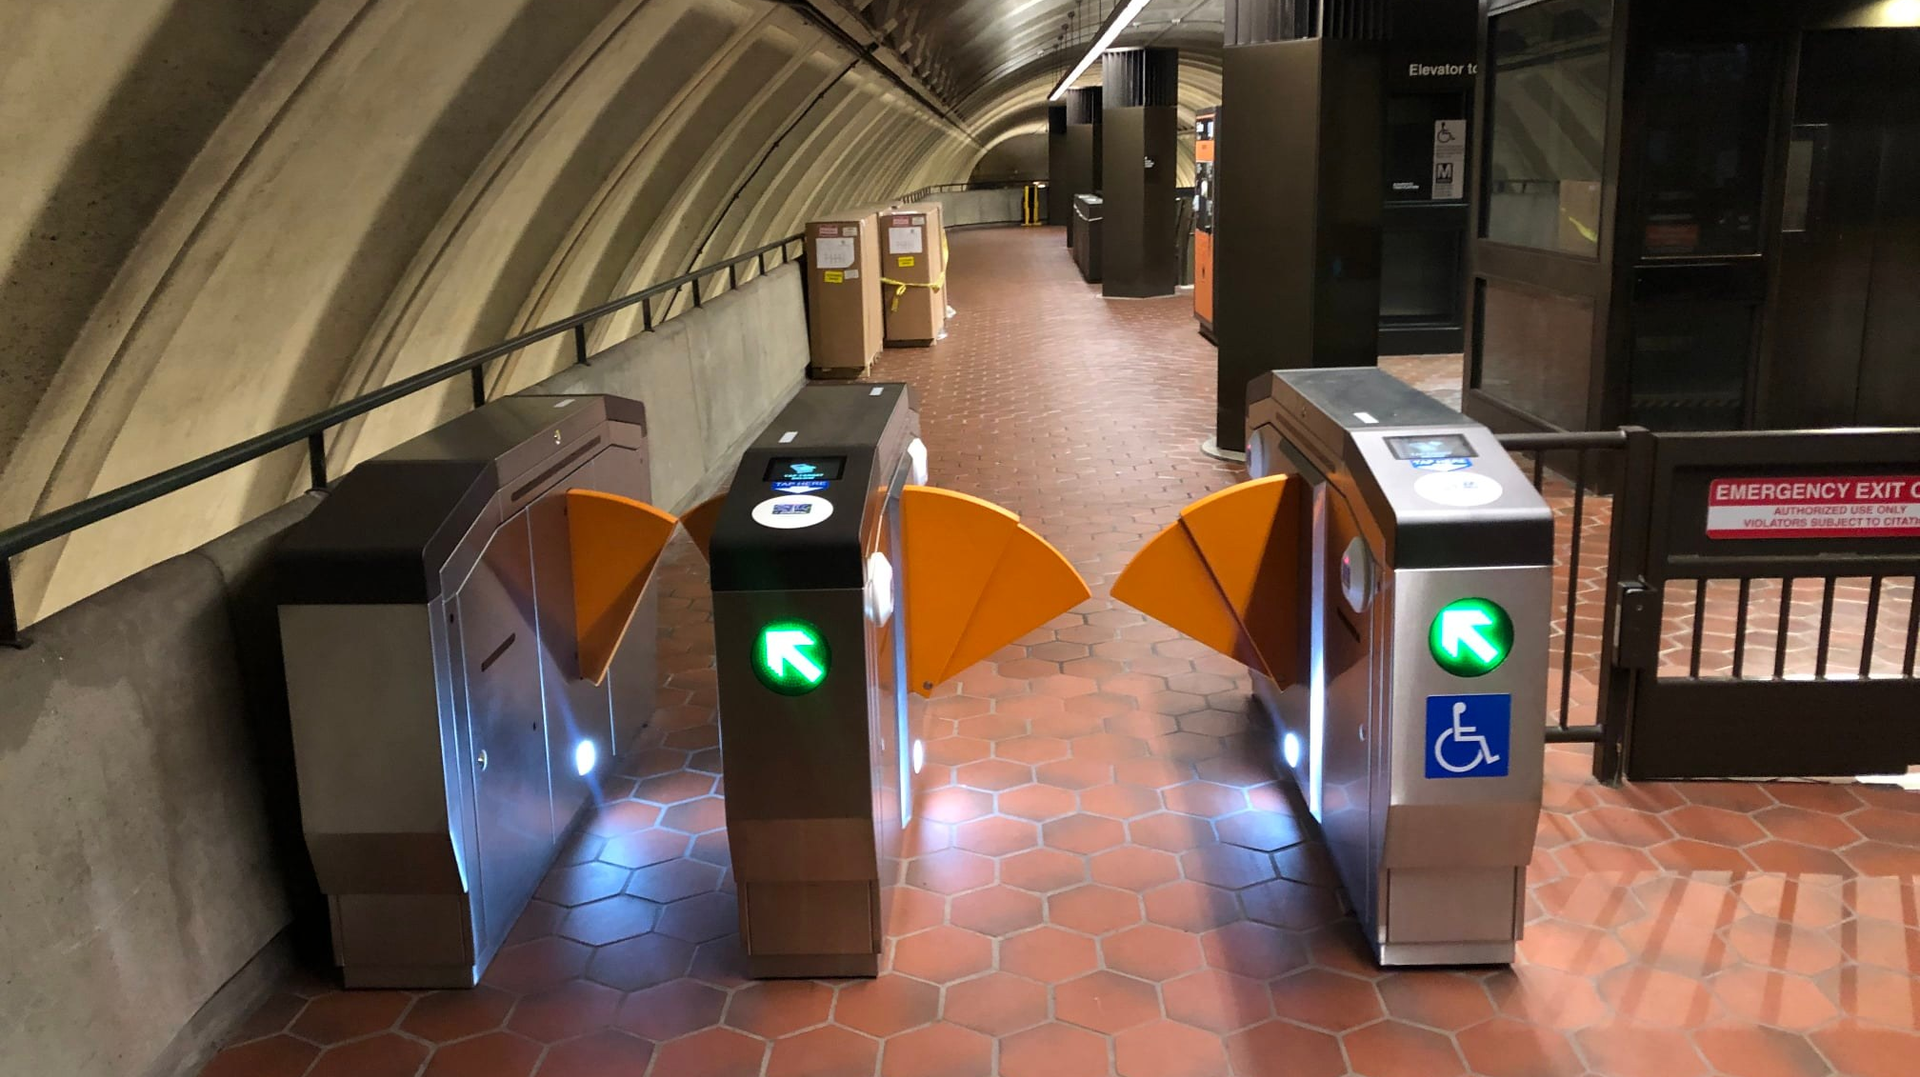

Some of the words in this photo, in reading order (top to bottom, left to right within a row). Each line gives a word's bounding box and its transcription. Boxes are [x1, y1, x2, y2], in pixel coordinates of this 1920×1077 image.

[1409, 63, 1464, 76] Elevator
[1716, 482, 1851, 500] EMERGENCY
[1855, 482, 1906, 499] EXIT
[1774, 505, 1848, 515] AUTHORIZED
[1850, 505, 1873, 514] USE
[1876, 505, 1908, 514] ONLY
[1743, 518, 1808, 528] VIOLATORS
[1811, 517, 1864, 527] SUBJECT
[1866, 517, 1880, 526] TO
[1883, 516, 1920, 526] CITATI
